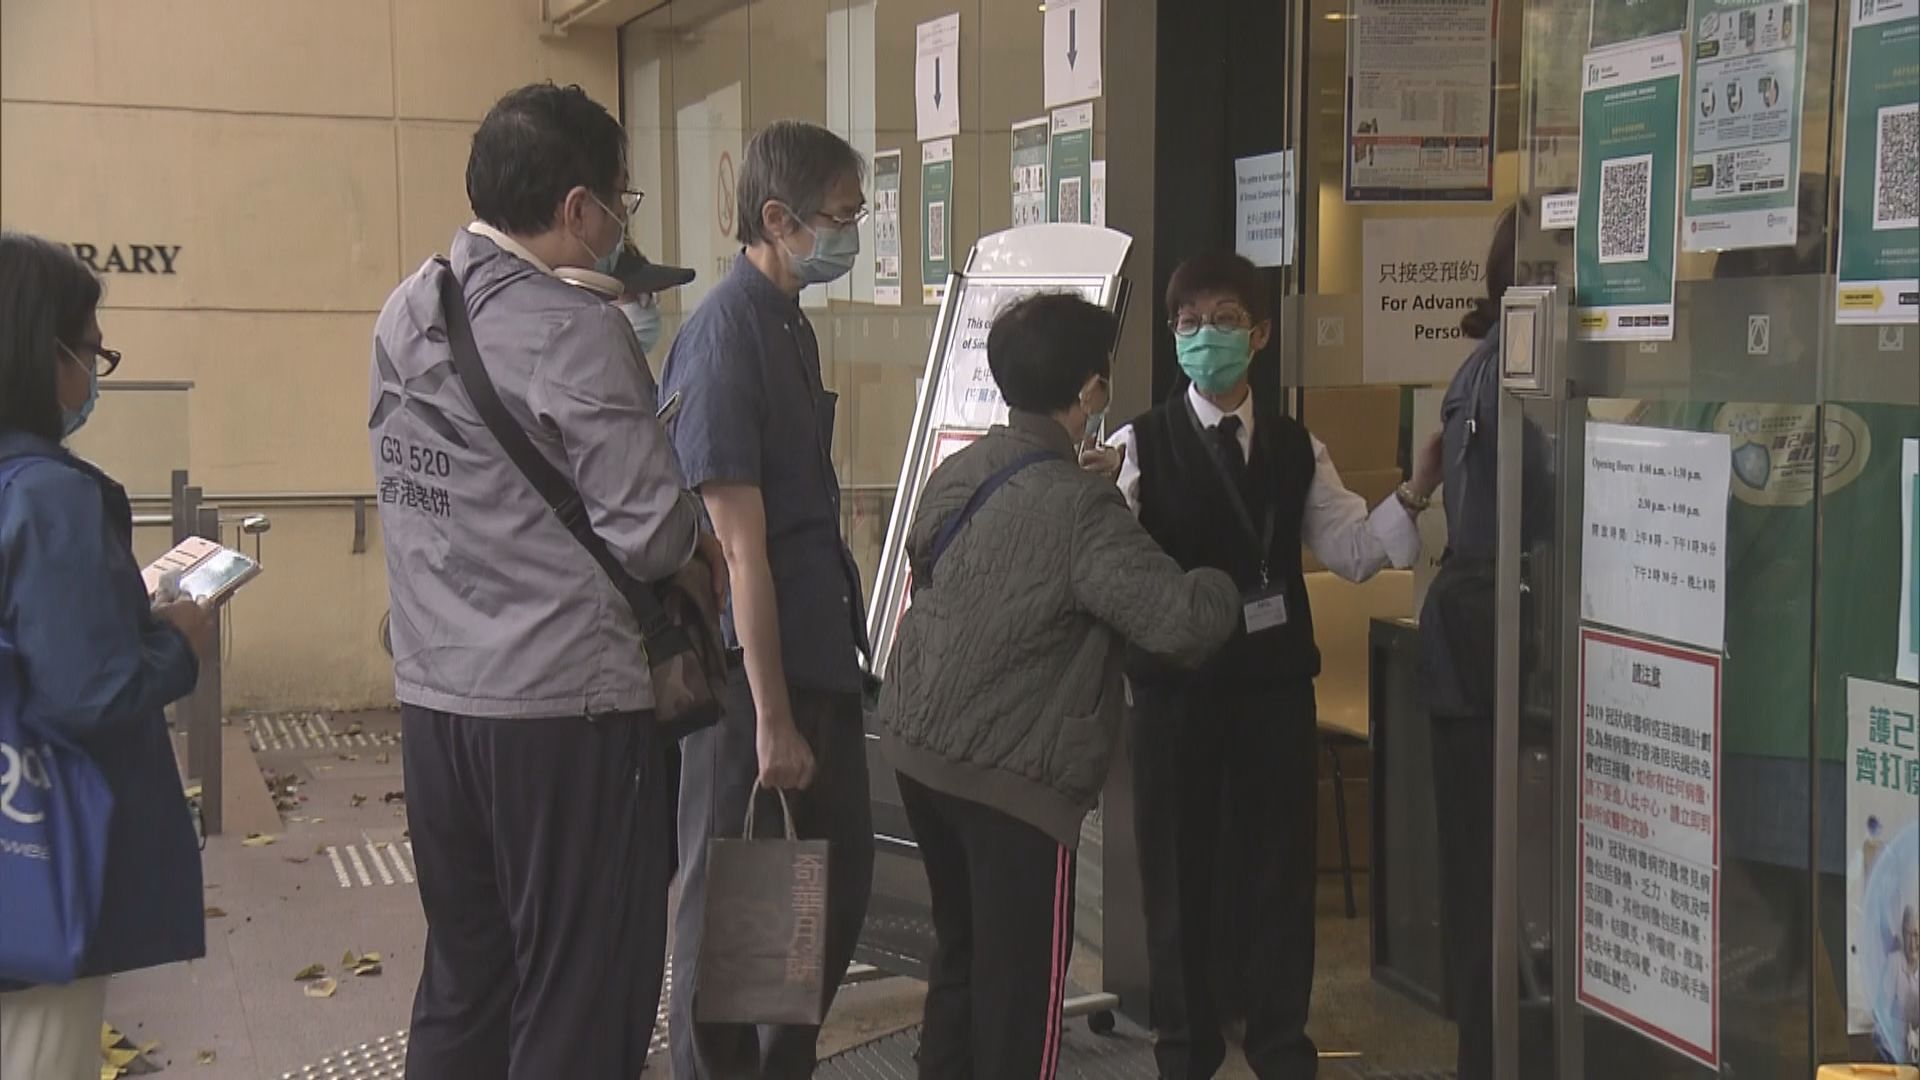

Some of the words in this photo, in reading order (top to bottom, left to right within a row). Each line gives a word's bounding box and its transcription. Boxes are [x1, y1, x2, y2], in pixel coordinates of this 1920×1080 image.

[72, 242, 182, 275] RARY
[1381, 295, 1408, 311] For
[1412, 294, 1474, 310] Advanc
[967, 317, 983, 329] This
[962, 338, 971, 350] of
[380, 435, 403, 465] G3
[409, 445, 451, 478] 520
[1592, 457, 1616, 473] Opening
[1586, 703, 1604, 721] 2019
[1868, 705, 1919, 752] 護己
